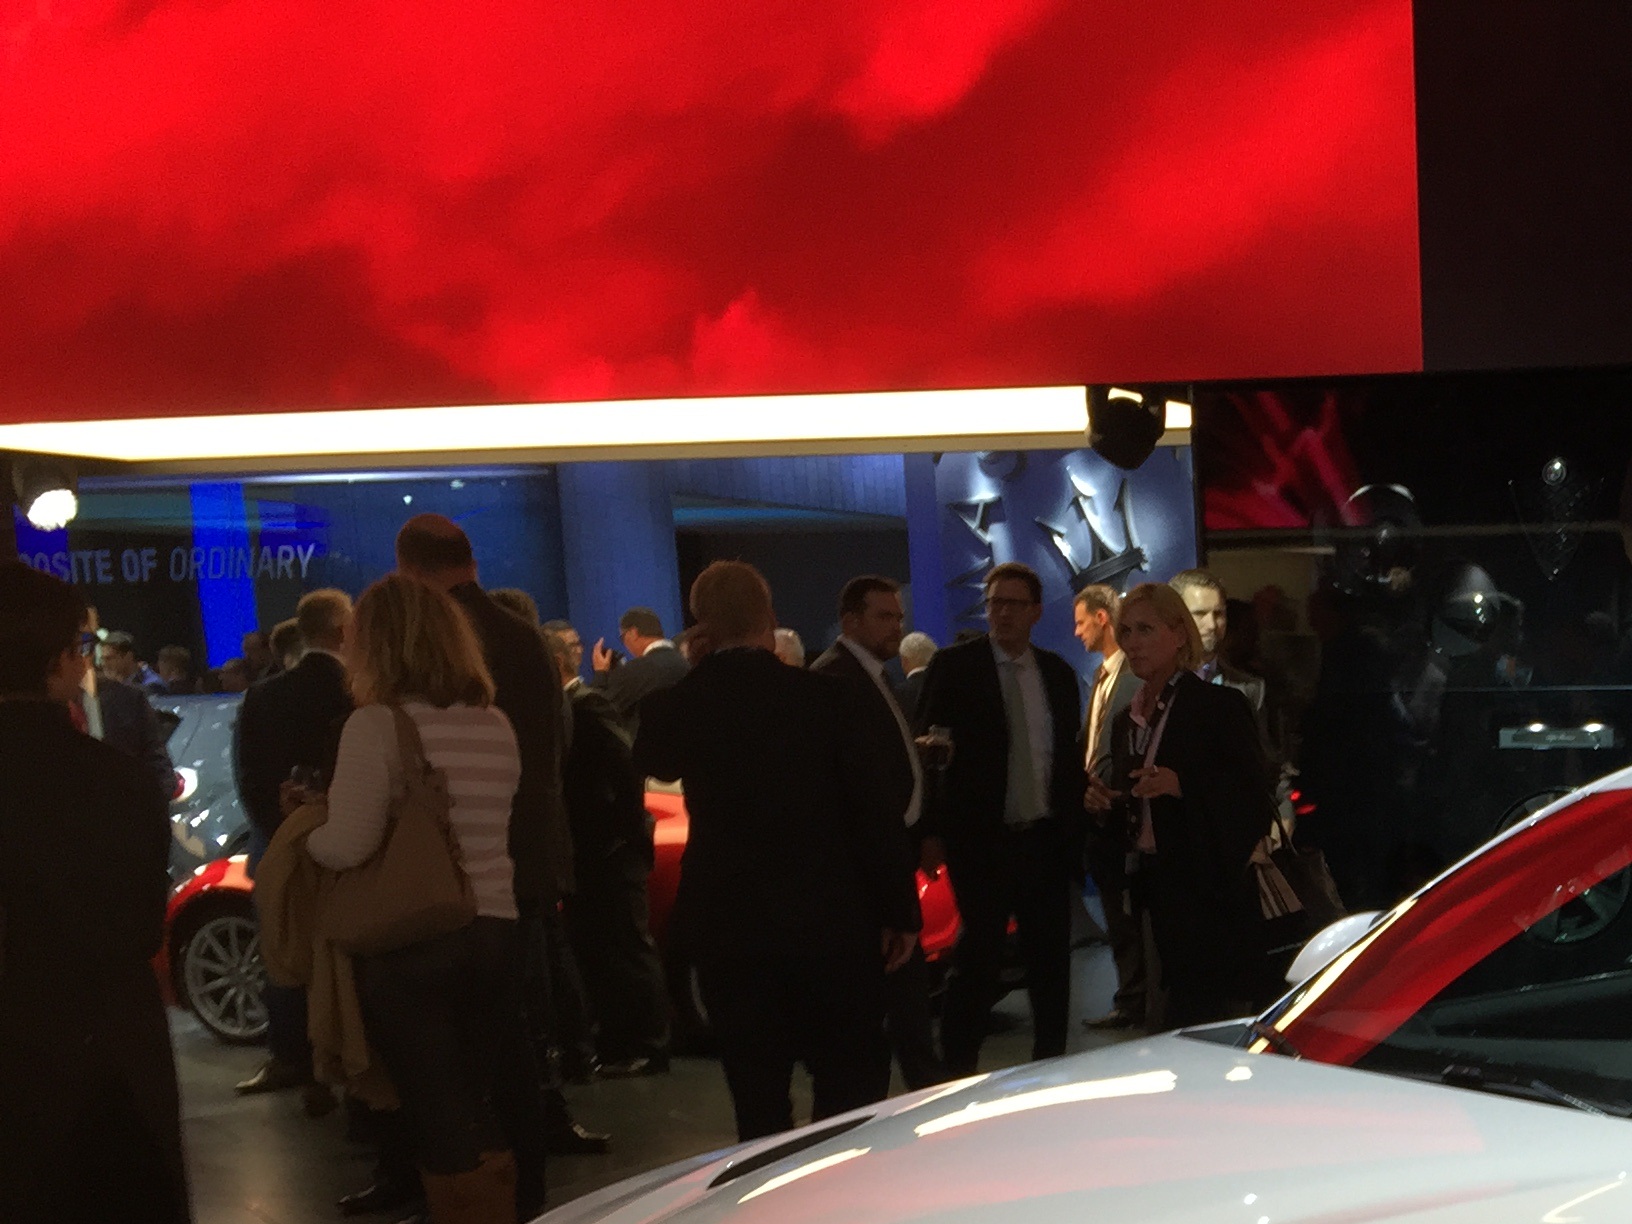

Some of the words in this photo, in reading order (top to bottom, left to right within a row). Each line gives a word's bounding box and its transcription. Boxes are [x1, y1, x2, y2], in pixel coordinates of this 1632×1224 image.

[18, 549, 114, 584] OSITE
[121, 547, 157, 582] OF
[168, 542, 316, 581] ORDINARY
